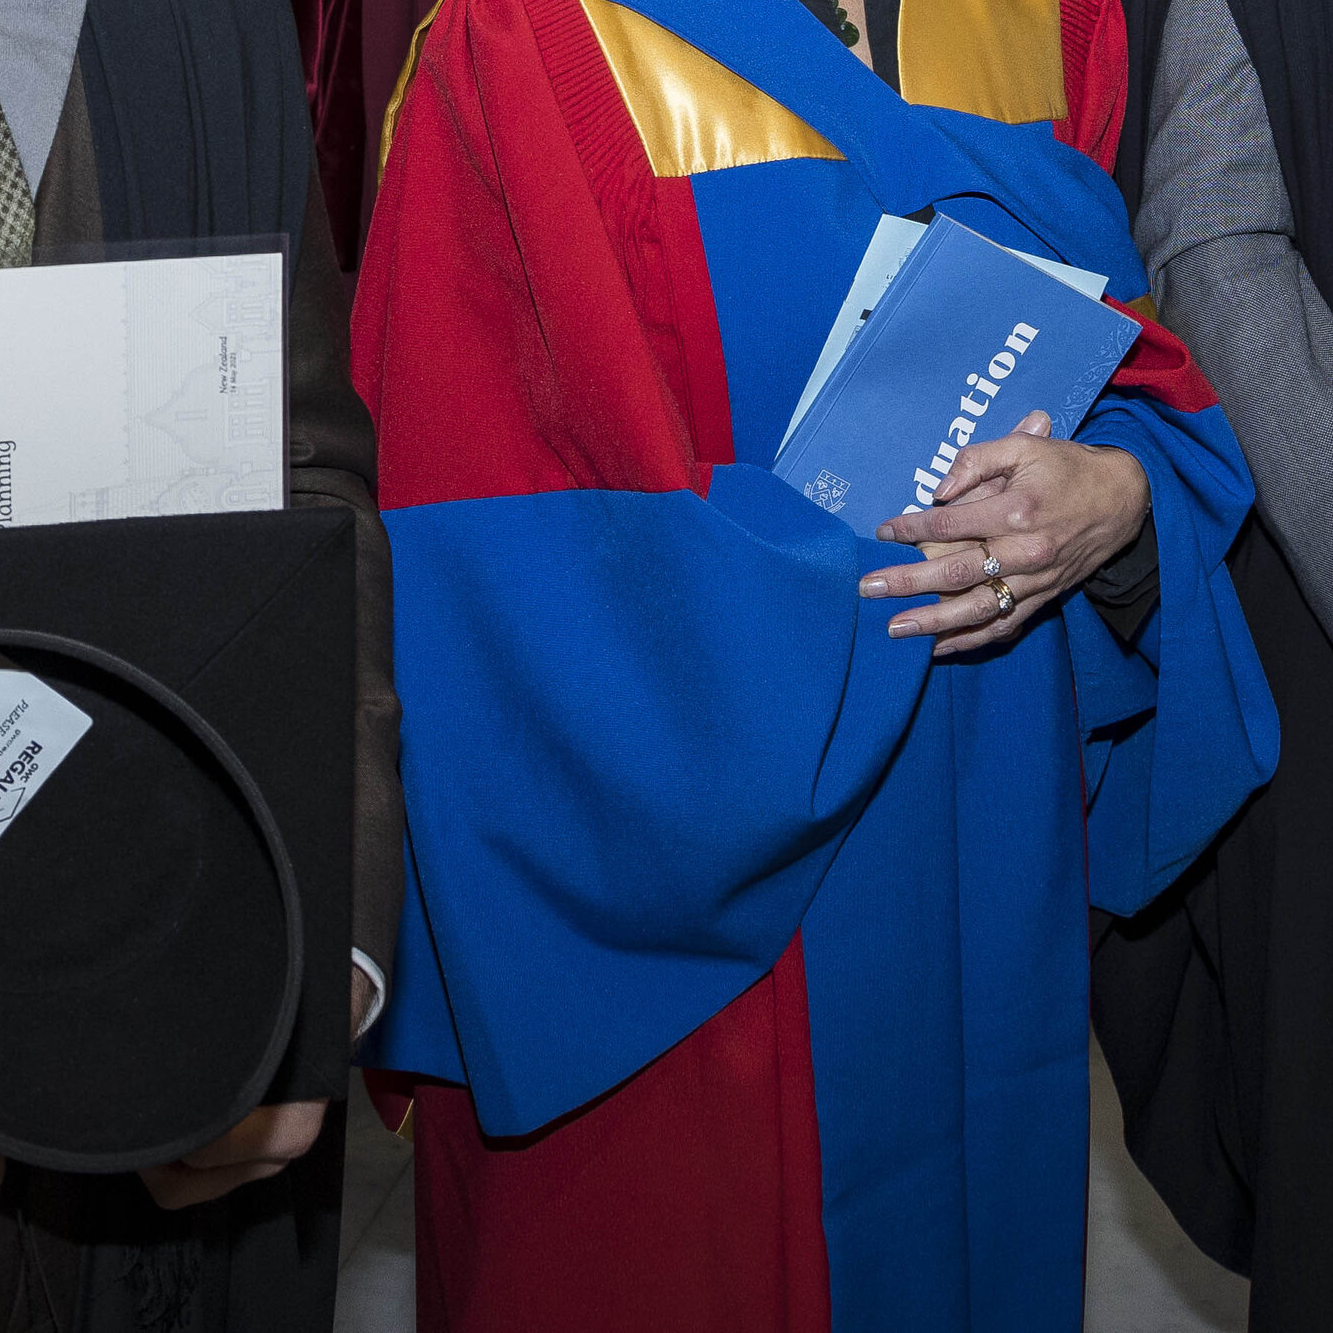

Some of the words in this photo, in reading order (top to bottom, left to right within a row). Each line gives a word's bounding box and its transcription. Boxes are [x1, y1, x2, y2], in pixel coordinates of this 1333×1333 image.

[219, 336, 228, 372] Zealand
[219, 373, 228, 394] New
[902, 322, 1040, 515] duation
[20, 763, 39, 783] GWC
